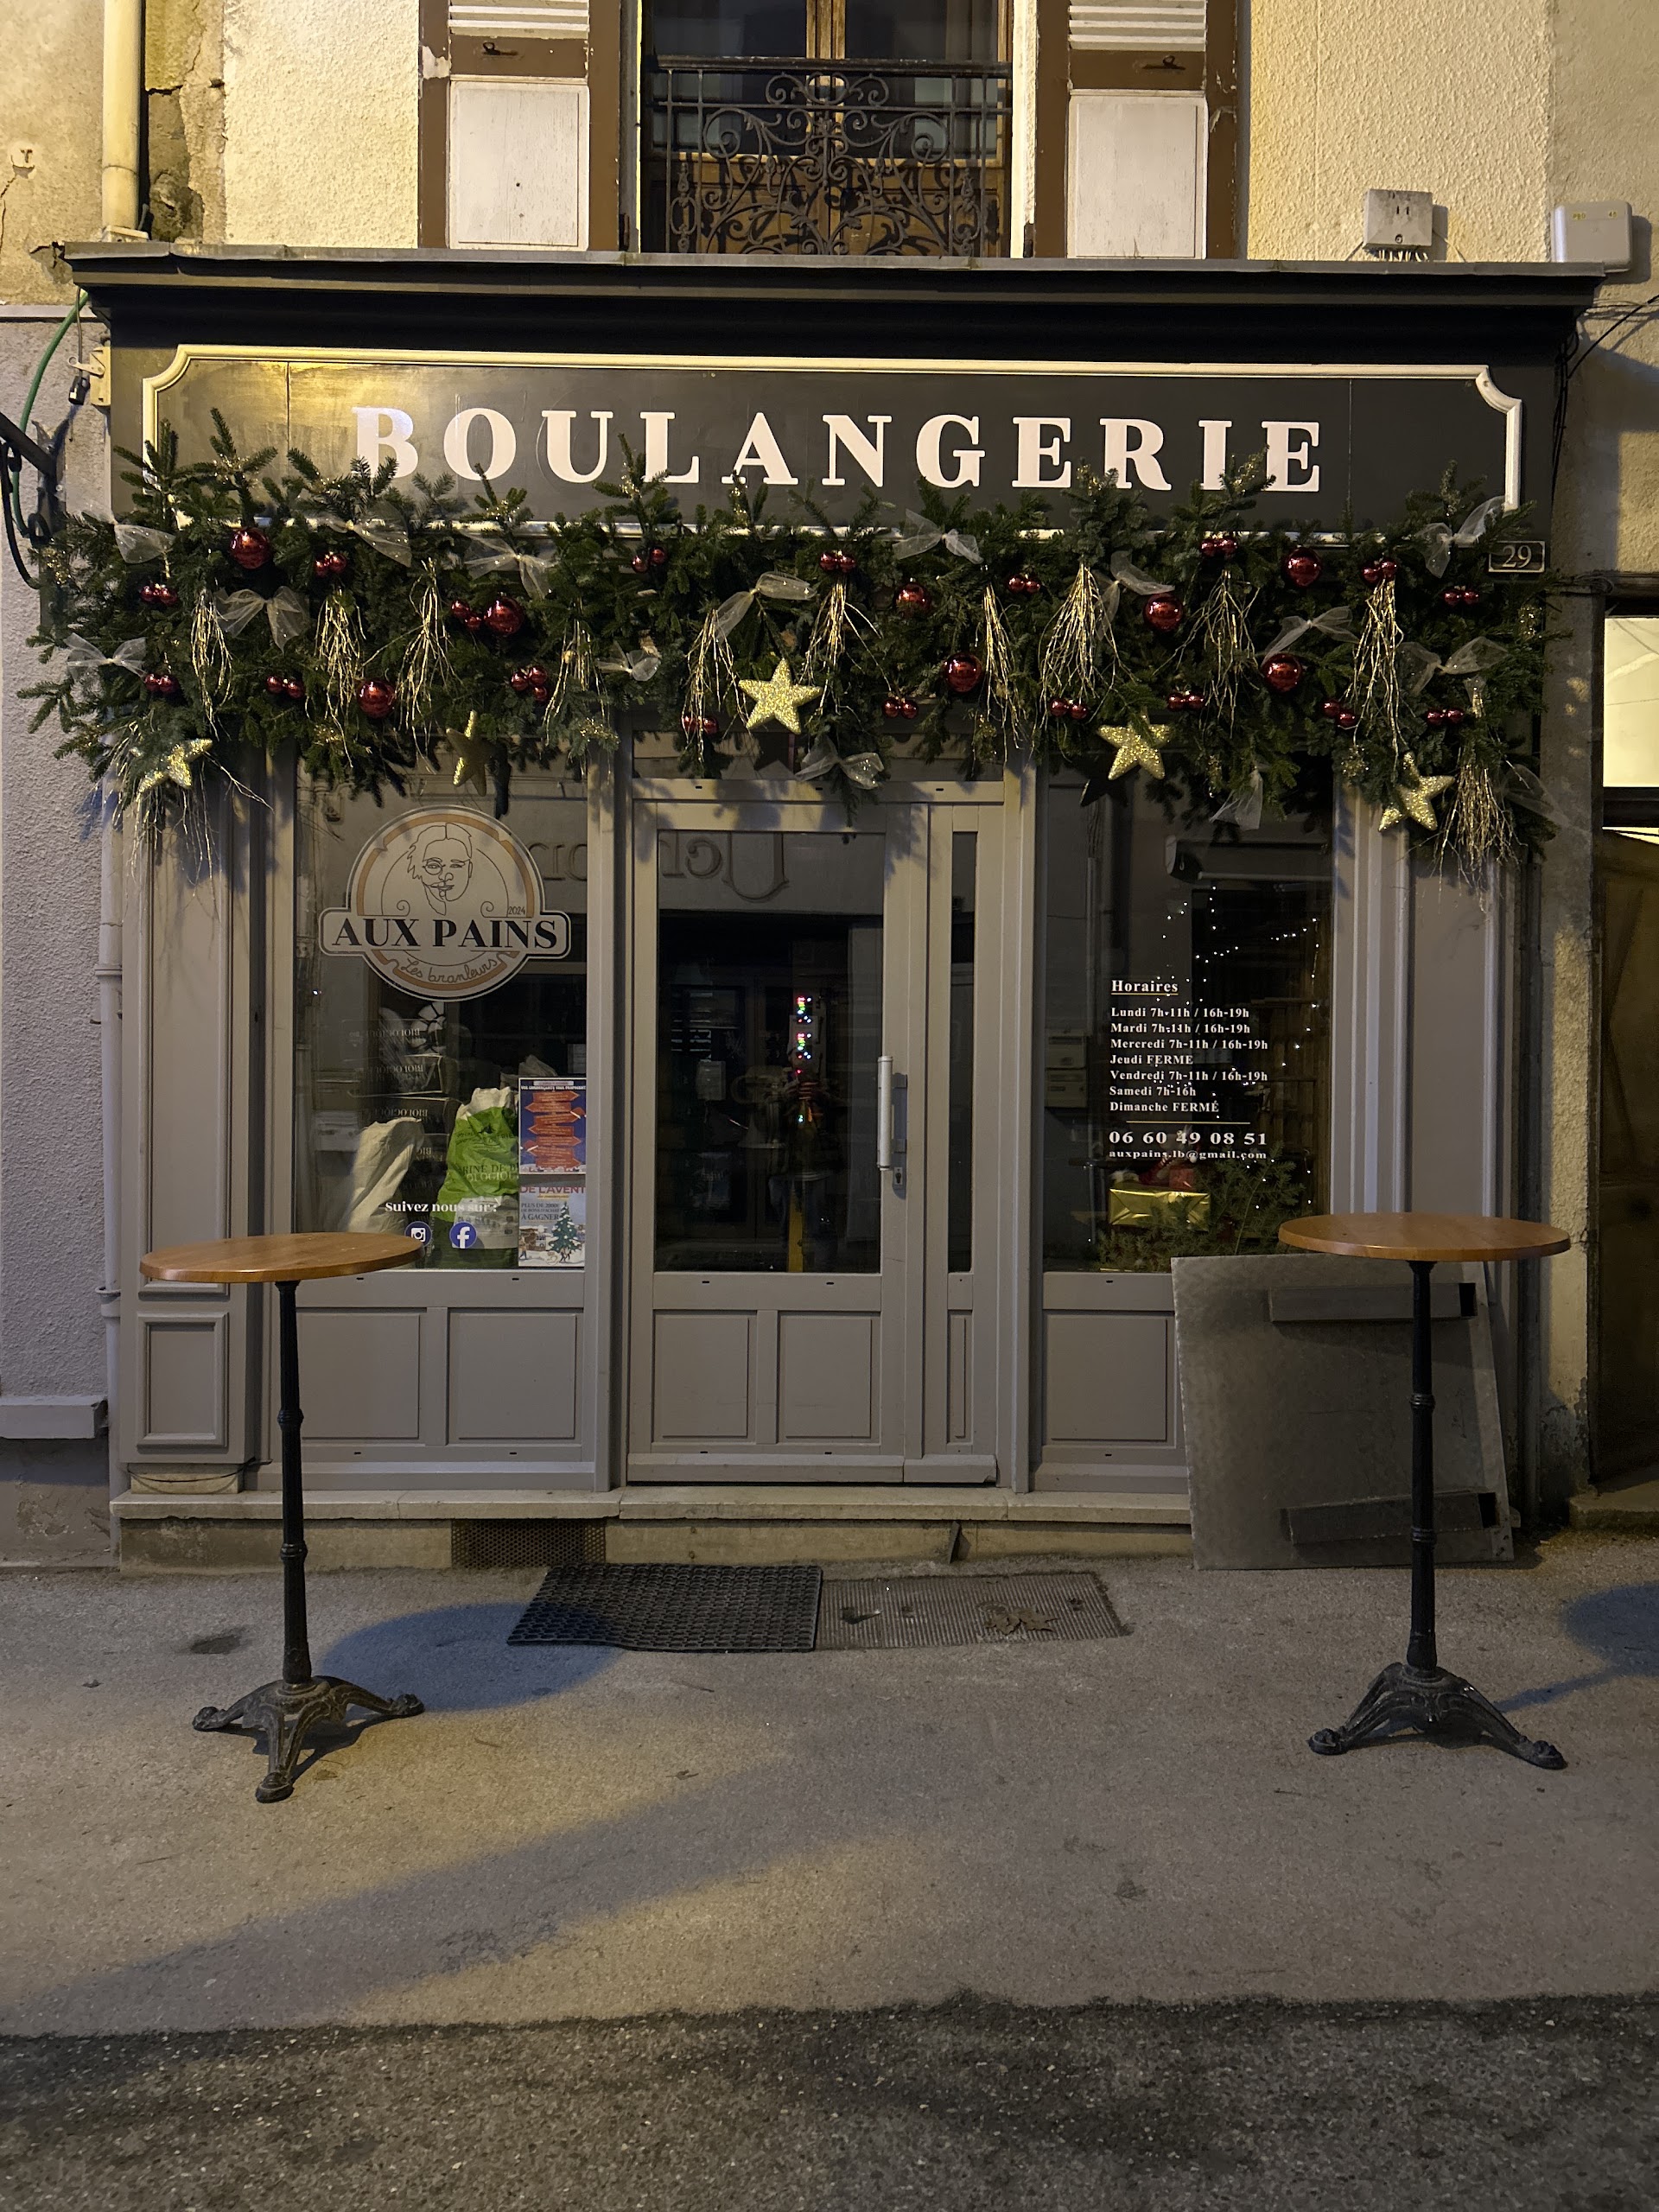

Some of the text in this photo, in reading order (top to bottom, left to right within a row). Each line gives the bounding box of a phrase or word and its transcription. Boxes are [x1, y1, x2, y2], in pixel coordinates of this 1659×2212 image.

[352, 407, 1319, 492] BOULANGERIE
[1502, 544, 1532, 569] 29
[506, 906, 525, 916] 2024
[332, 918, 557, 949] AUX PAINS
[401, 957, 498, 983] Les branleurs
[1111, 980, 1179, 993] Horaires
[1111, 1007, 1249, 1018] Lundi 7h-11h / 16h-19h
[1110, 1023, 1250, 1033] Mardi 7h-11h / 16h-19h
[1110, 1039, 1268, 1050] Mercredi 7h-11h / 16h-19h
[1109, 1054, 1142, 1065] Jeudi
[1110, 1071, 1268, 1081] Vendredi 7h-11h / 16h-19h
[1109, 1086, 1196, 1096] Samedi 7h-16h
[1109, 1100, 1219, 1112] Dimanche FERMÉ
[1109, 1131, 1267, 1144] 06 60 49 08 51
[1109, 1150, 1267, 1160] auxpains.lb@gmail.com
[385, 1201, 429, 1212] Suivez
[432, 1203, 464, 1212] nous
[467, 1204, 491, 1212] sur
